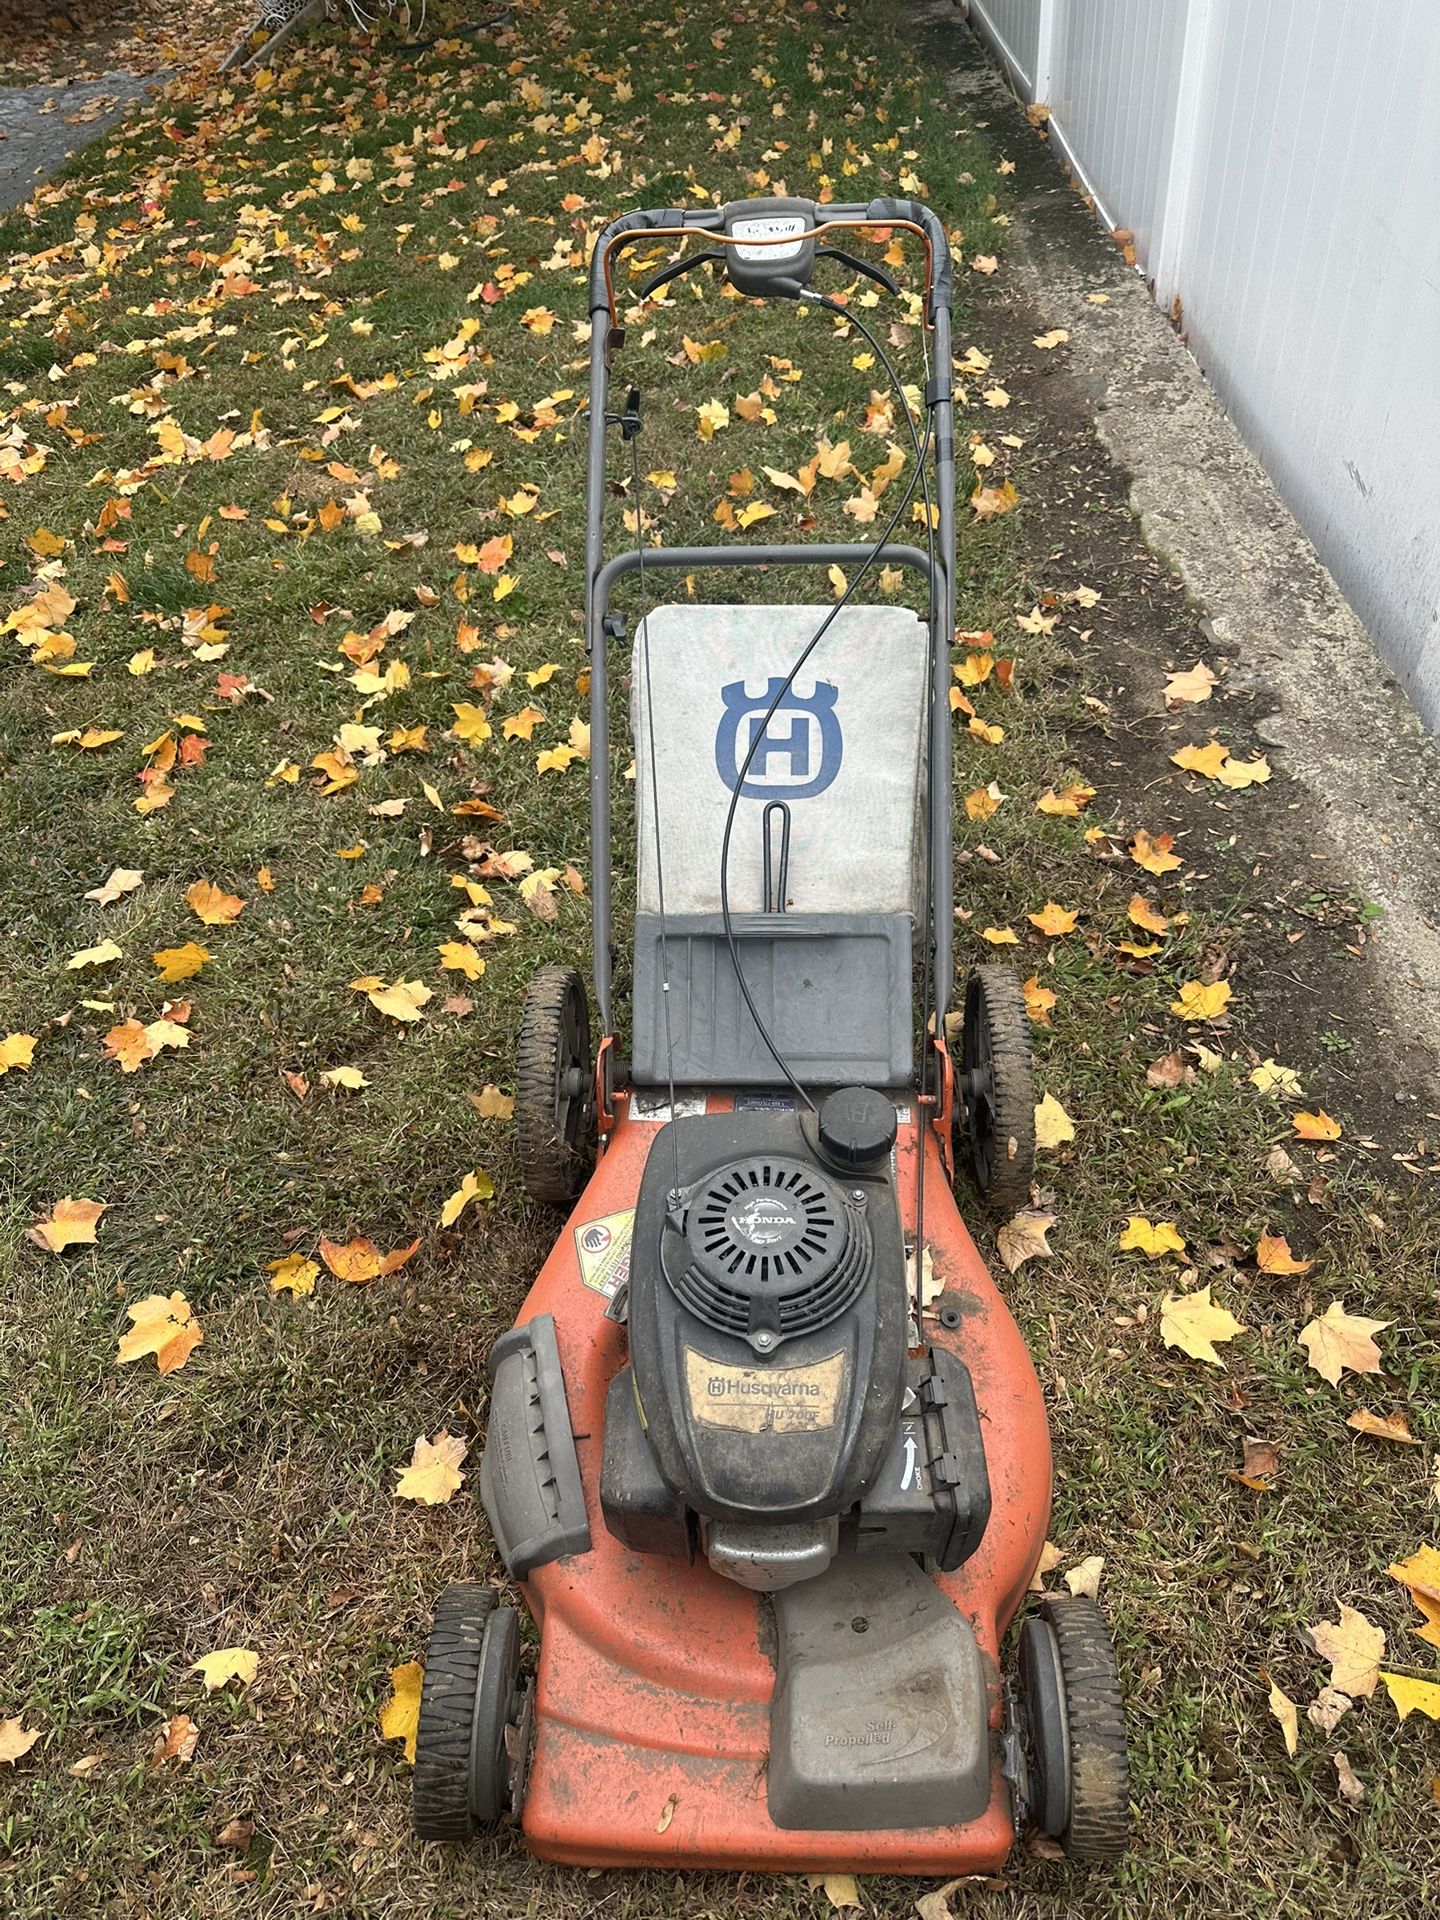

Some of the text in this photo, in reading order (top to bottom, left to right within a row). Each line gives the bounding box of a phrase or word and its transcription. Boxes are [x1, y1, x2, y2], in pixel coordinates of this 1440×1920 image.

[738, 1215, 797, 1225] HONDA
[727, 1380, 820, 1397] Husqvarna
[914, 1466, 923, 1490] CHOKE
[866, 1720, 897, 1731] Self-
[825, 1732, 890, 1748] Propelled
